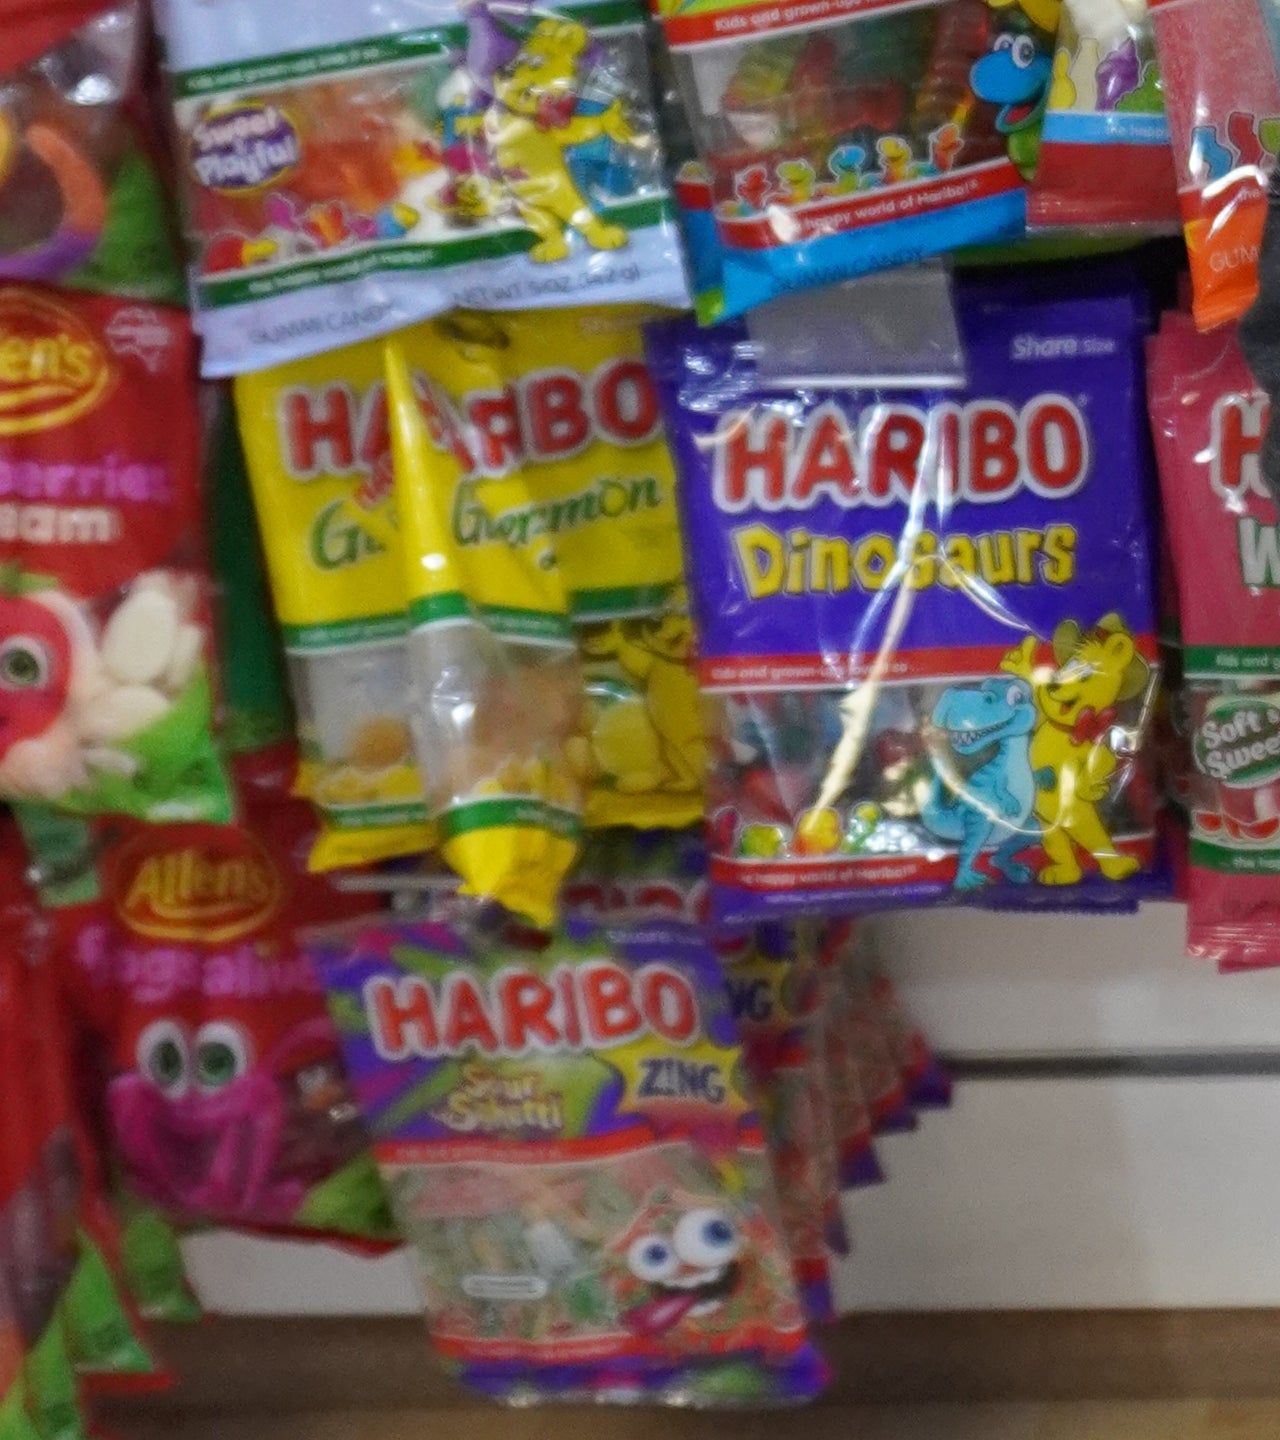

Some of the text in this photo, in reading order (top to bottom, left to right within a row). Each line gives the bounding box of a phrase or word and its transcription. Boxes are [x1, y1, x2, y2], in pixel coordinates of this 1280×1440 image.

[854, 202, 897, 220] world
[1010, 334, 1078, 362] Share
[712, 391, 1090, 514] HARIBO
[731, 523, 1080, 601] Dinosaurs
[1203, 708, 1260, 750] Soft
[364, 961, 699, 1058] HARIBO
